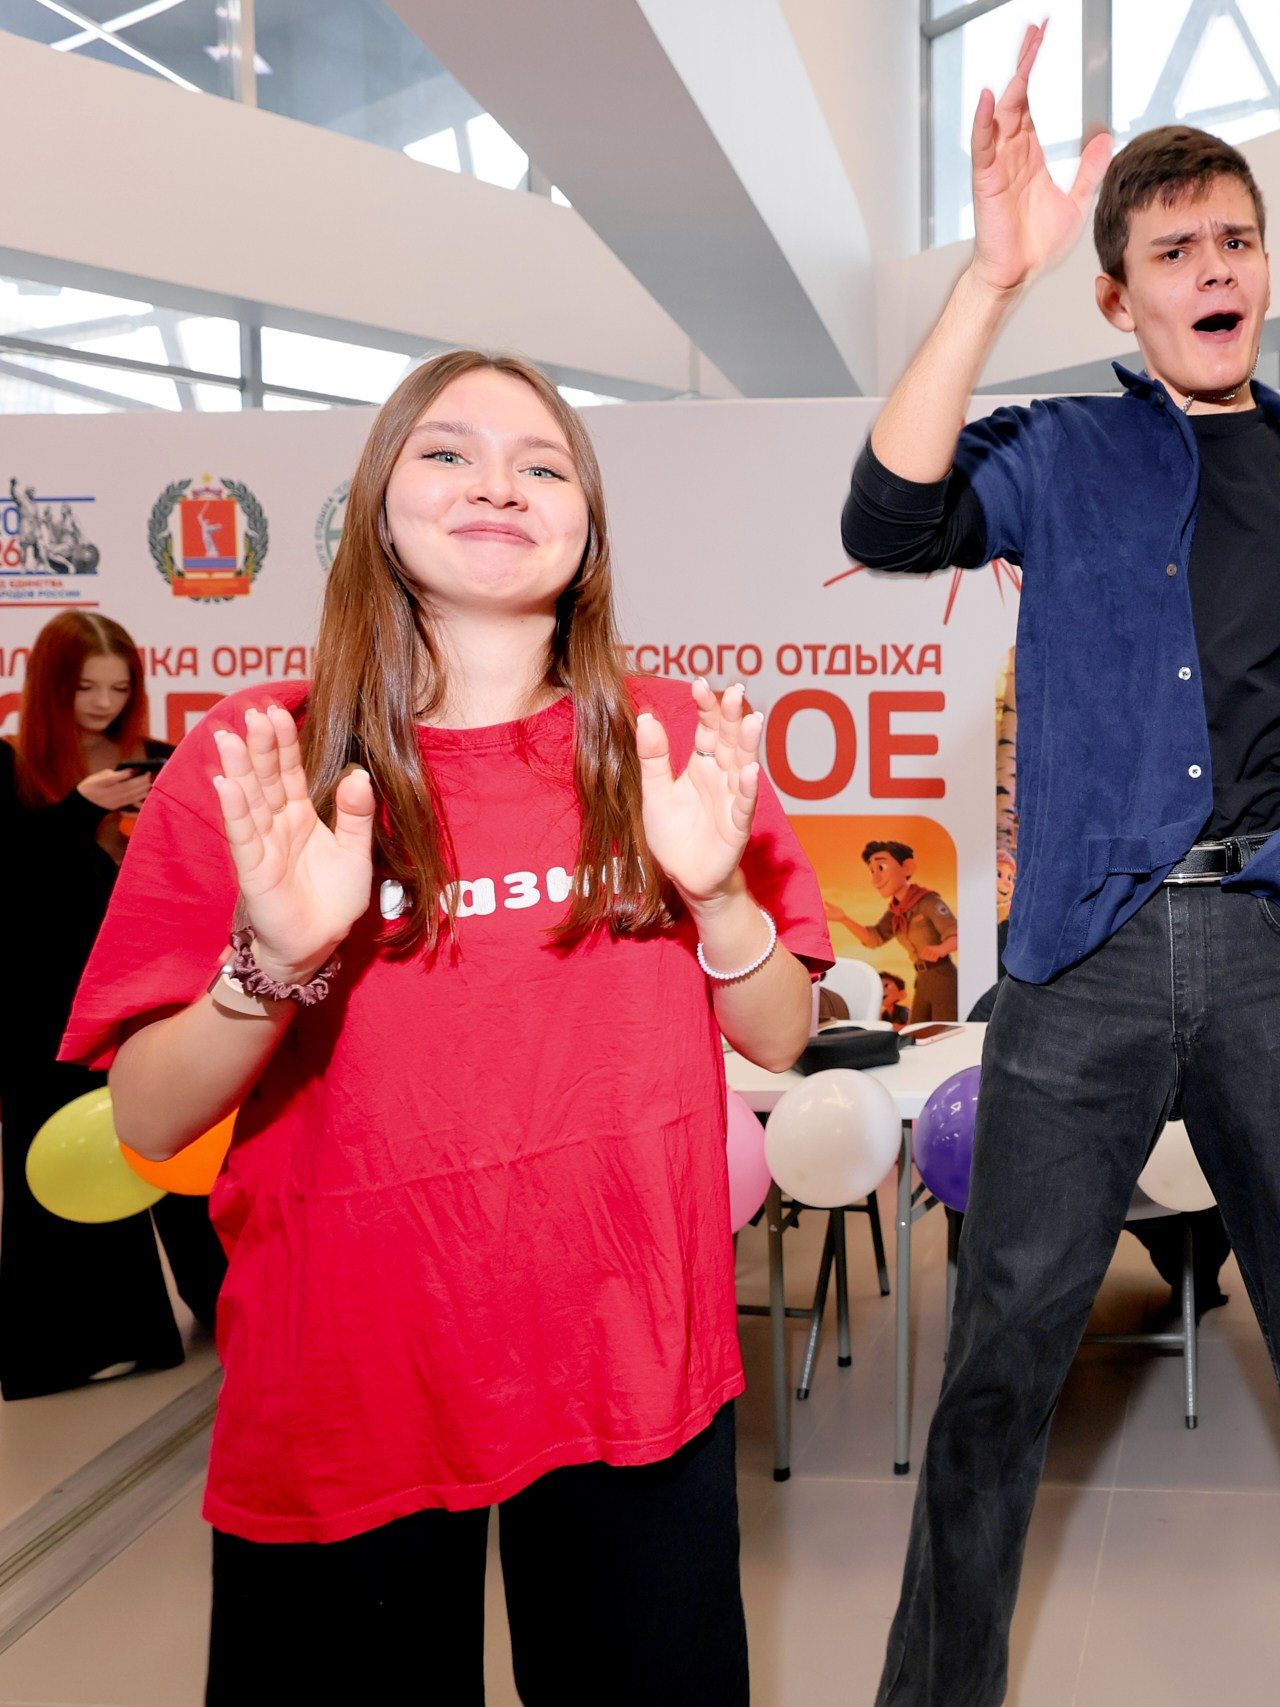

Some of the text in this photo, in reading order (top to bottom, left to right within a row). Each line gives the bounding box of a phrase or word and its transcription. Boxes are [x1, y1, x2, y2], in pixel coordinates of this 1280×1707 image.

[211, 646, 315, 676] ОРГА
[776, 644, 942, 676] ОТДЫХА
[714, 688, 946, 801] ОЕ
